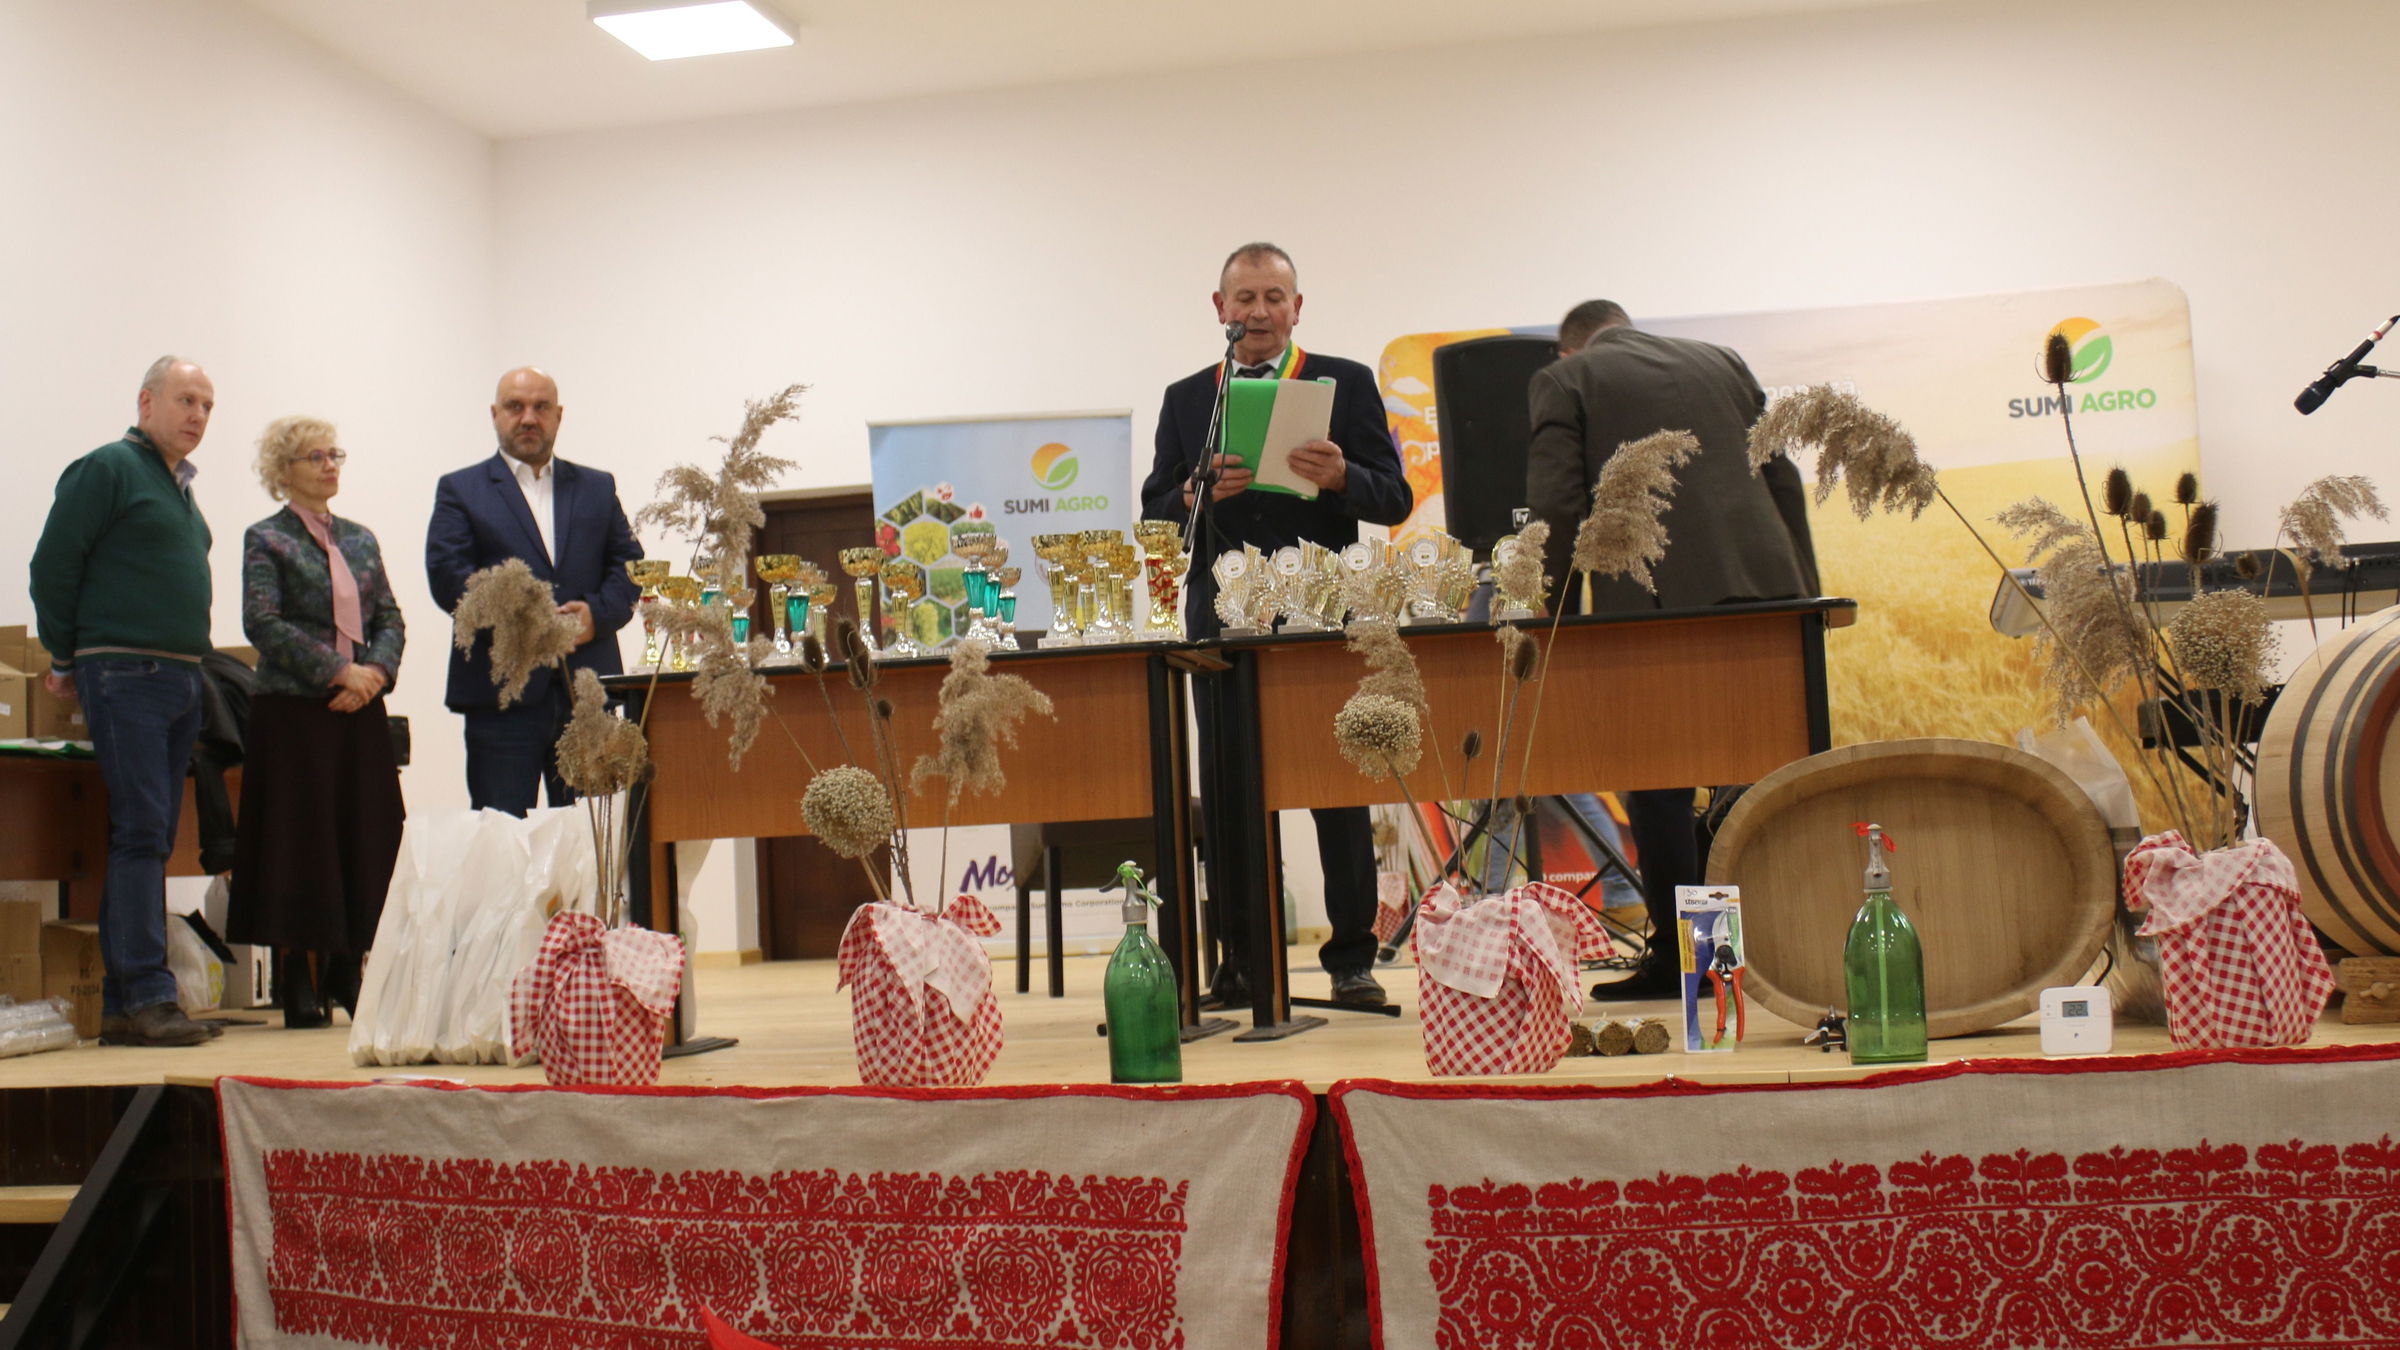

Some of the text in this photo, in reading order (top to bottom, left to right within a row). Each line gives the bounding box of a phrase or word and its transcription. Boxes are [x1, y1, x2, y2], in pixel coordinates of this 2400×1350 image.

[2008, 388, 2157, 418] SUMI AGRO
[1004, 495, 1109, 515] SUMI AGRO
